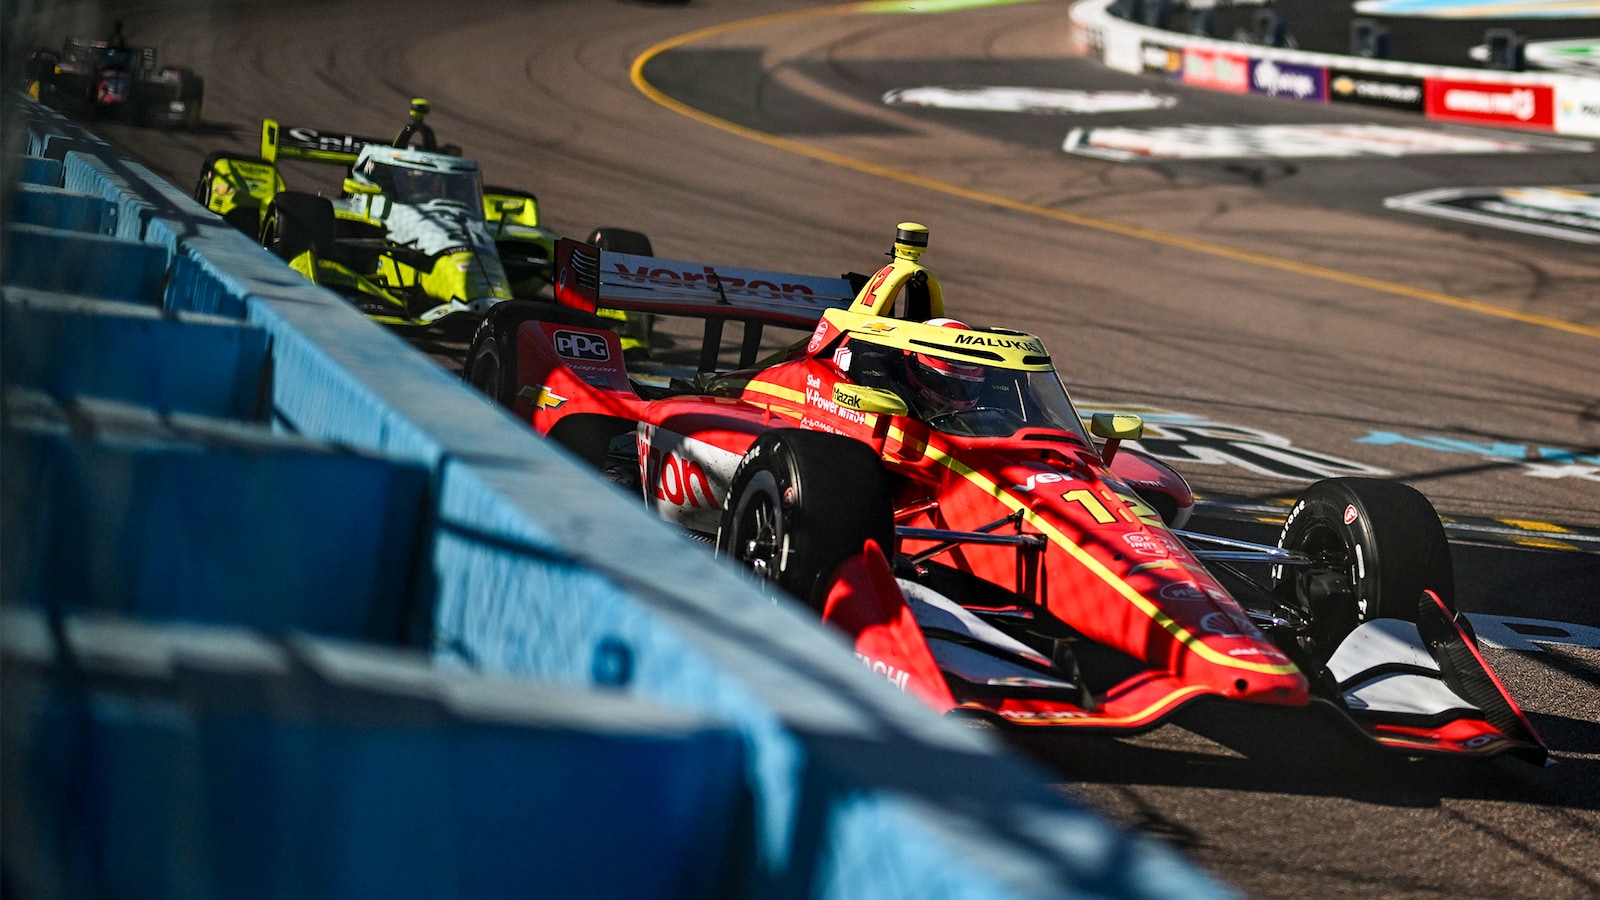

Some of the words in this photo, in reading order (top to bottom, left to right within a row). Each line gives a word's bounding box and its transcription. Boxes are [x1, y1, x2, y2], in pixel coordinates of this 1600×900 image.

[613, 263, 817, 303] verizon
[556, 334, 607, 357] PPG
[805, 373, 821, 390] Shell
[805, 386, 839, 415] V-Power
[833, 386, 861, 409] Mazak
[1062, 489, 1166, 530] 12
